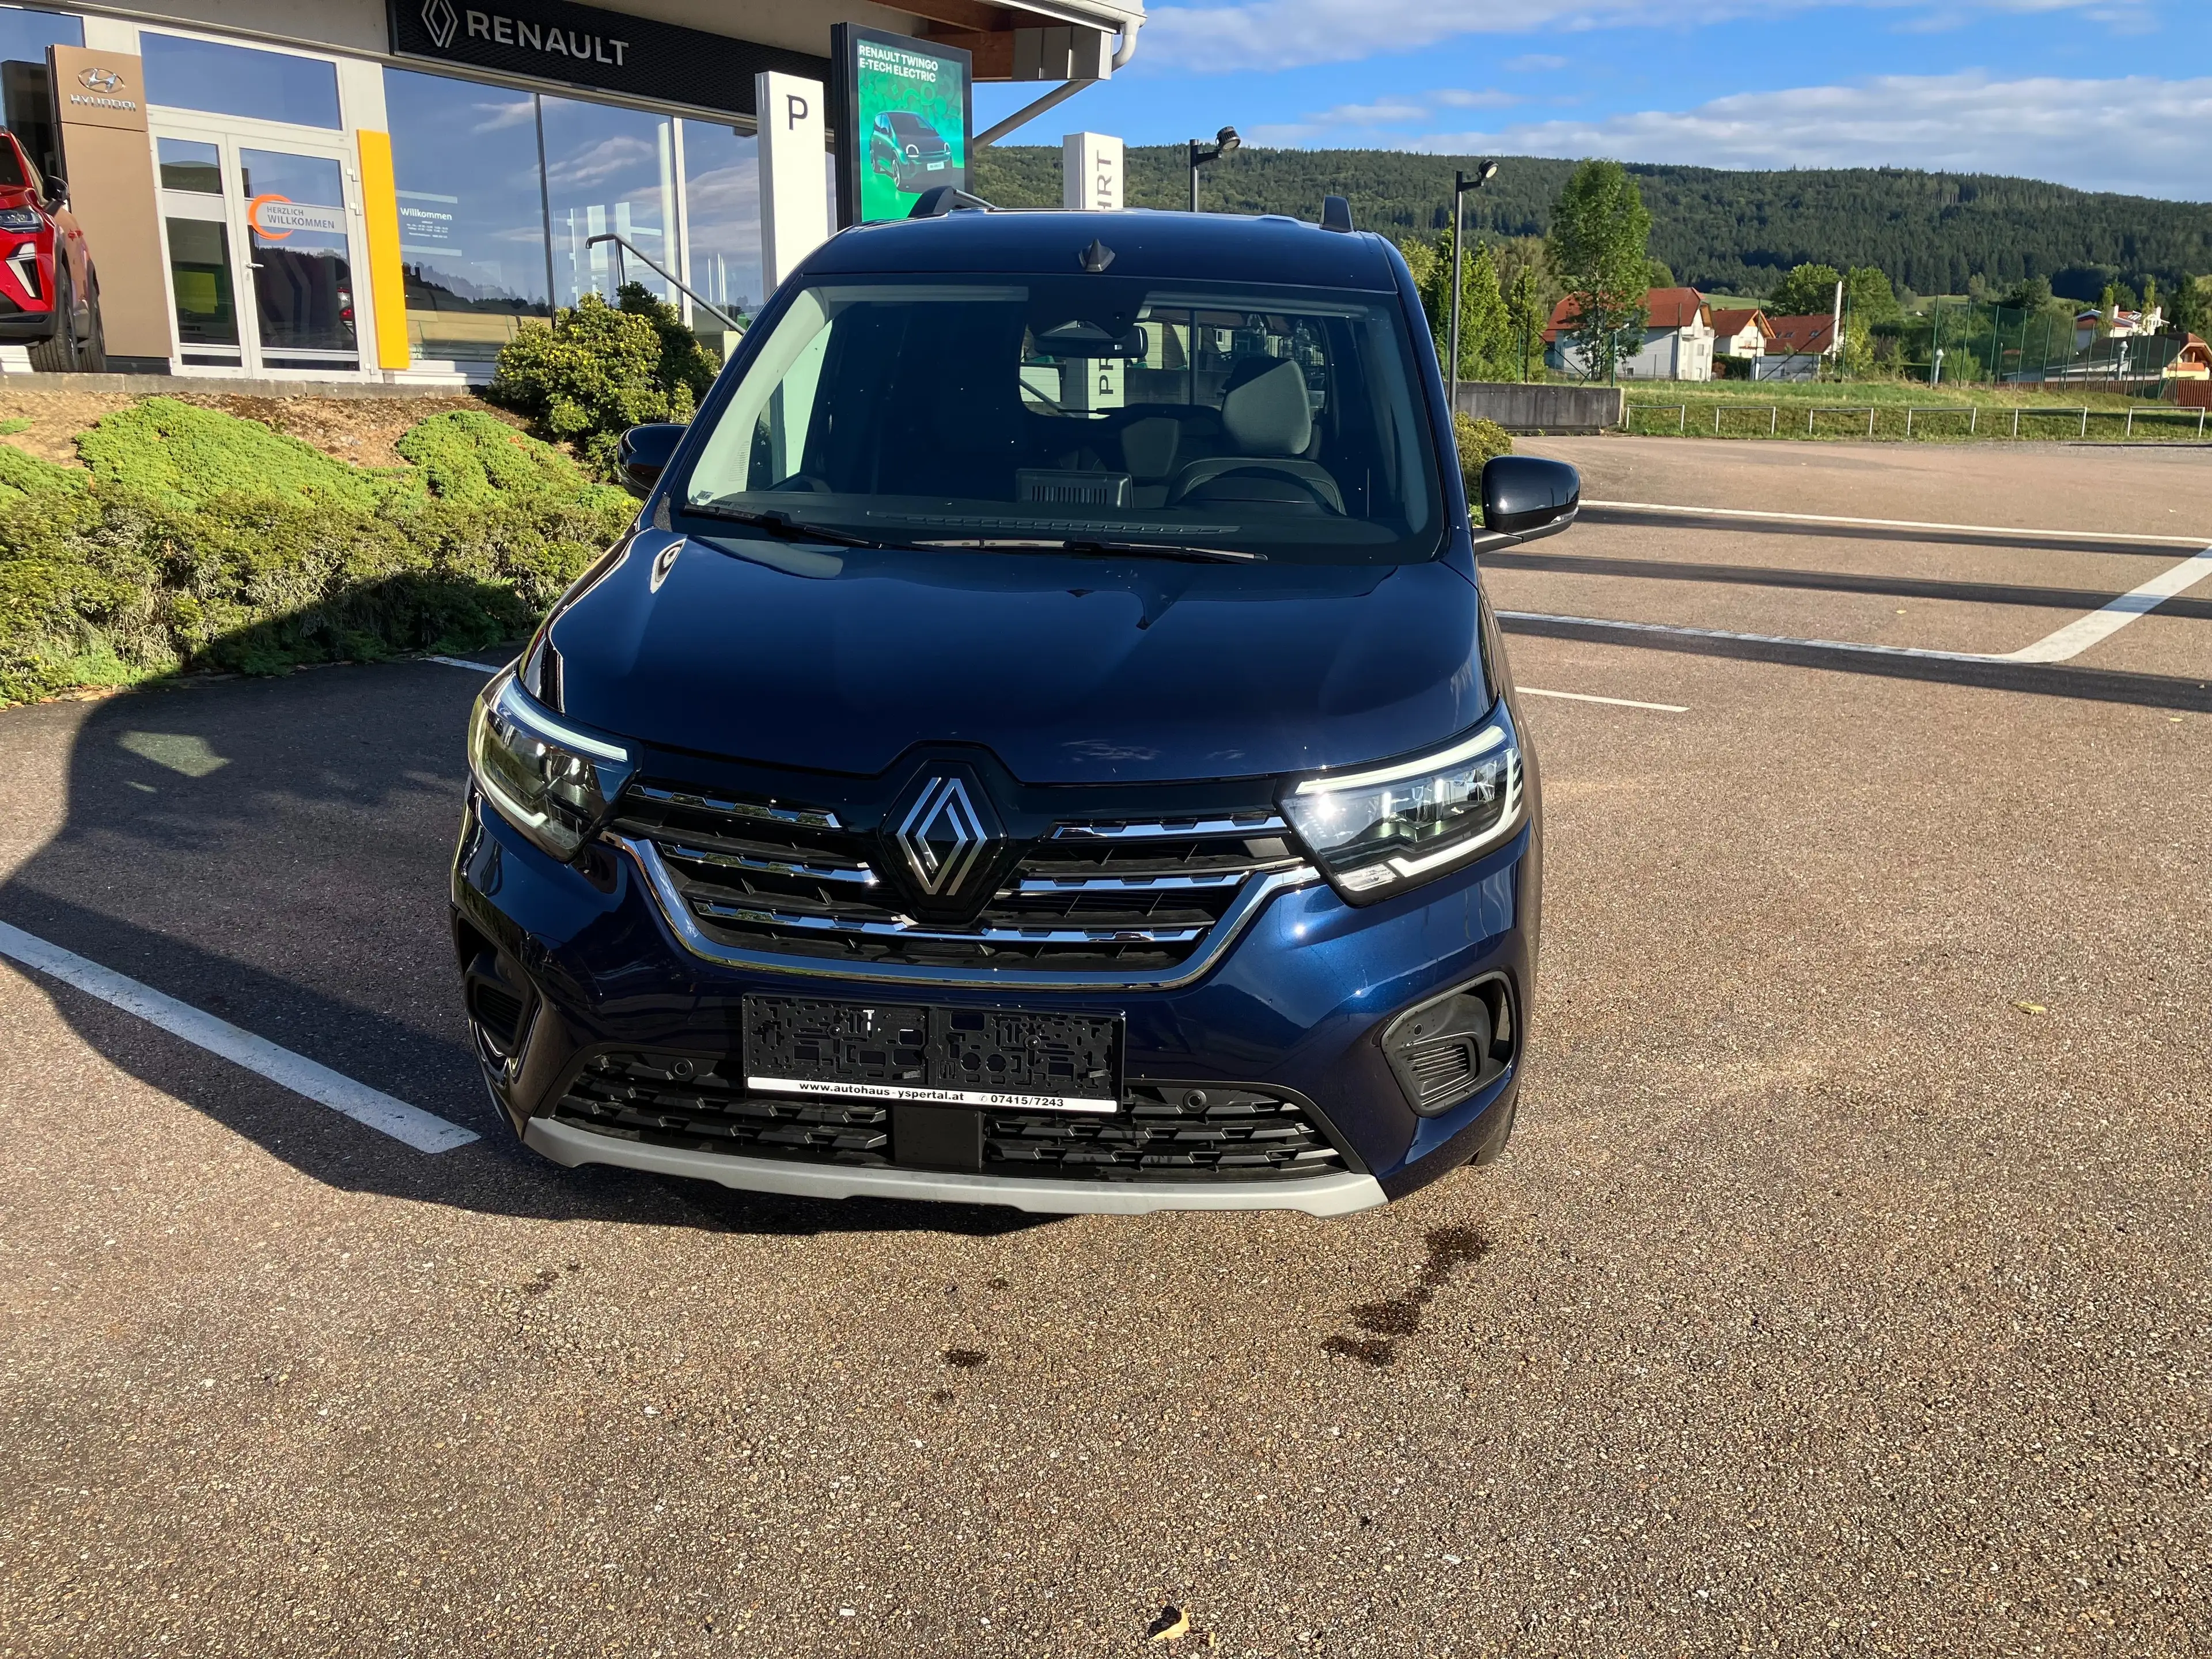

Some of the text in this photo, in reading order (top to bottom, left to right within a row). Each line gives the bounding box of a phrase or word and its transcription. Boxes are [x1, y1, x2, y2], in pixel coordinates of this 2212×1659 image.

[466, 10, 629, 66] RENAULT
[859, 45, 938, 71] RENAULT TWINGO
[859, 58, 936, 82] E-TECH ELECTRIC
[70, 94, 136, 112] HYUNDAI
[786, 94, 808, 130] P
[267, 206, 304, 216] HERZLICH
[400, 207, 452, 220] Willkommen
[267, 215, 335, 229] WILLKOMMEN
[991, 1094, 1063, 1107] 07415/7243
